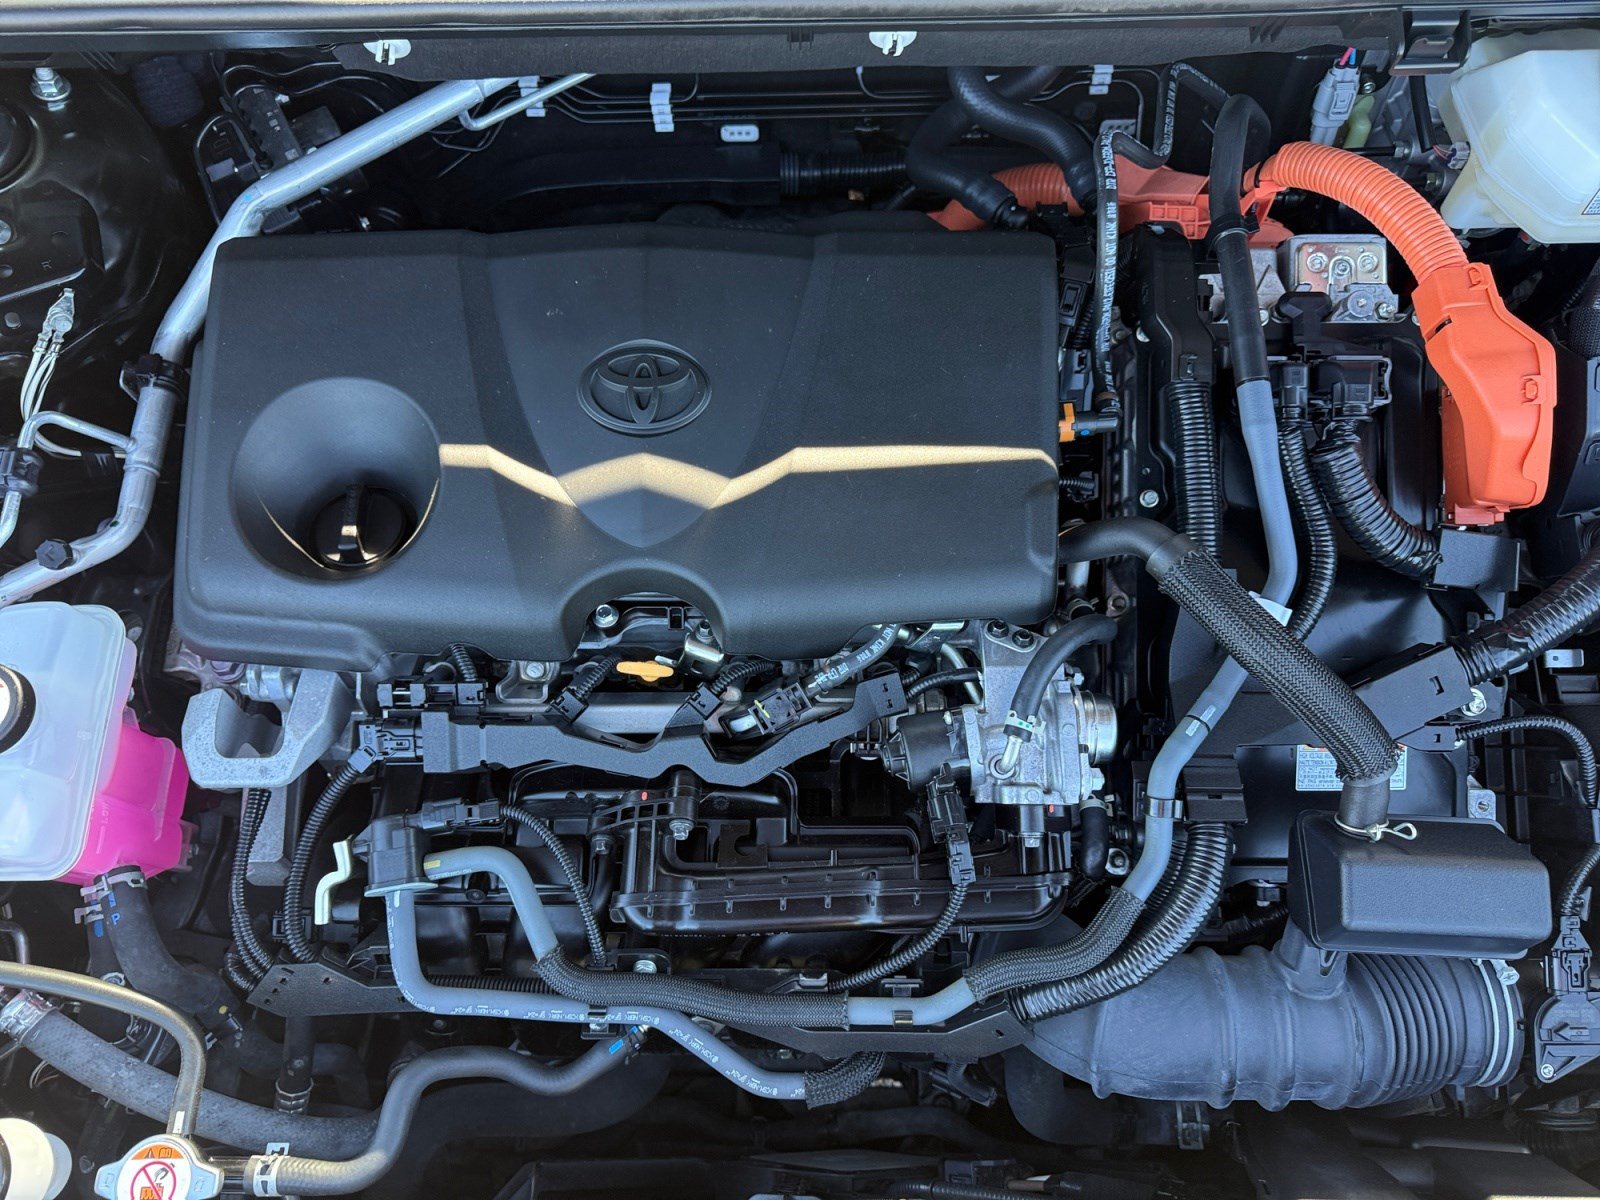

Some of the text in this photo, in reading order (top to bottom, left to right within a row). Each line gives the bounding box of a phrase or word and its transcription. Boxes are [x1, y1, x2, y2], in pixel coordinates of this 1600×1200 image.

[1104, 222, 1117, 239] KINK
[1104, 243, 1117, 255] NOT
[869, 627, 895, 654] NOT KINK
